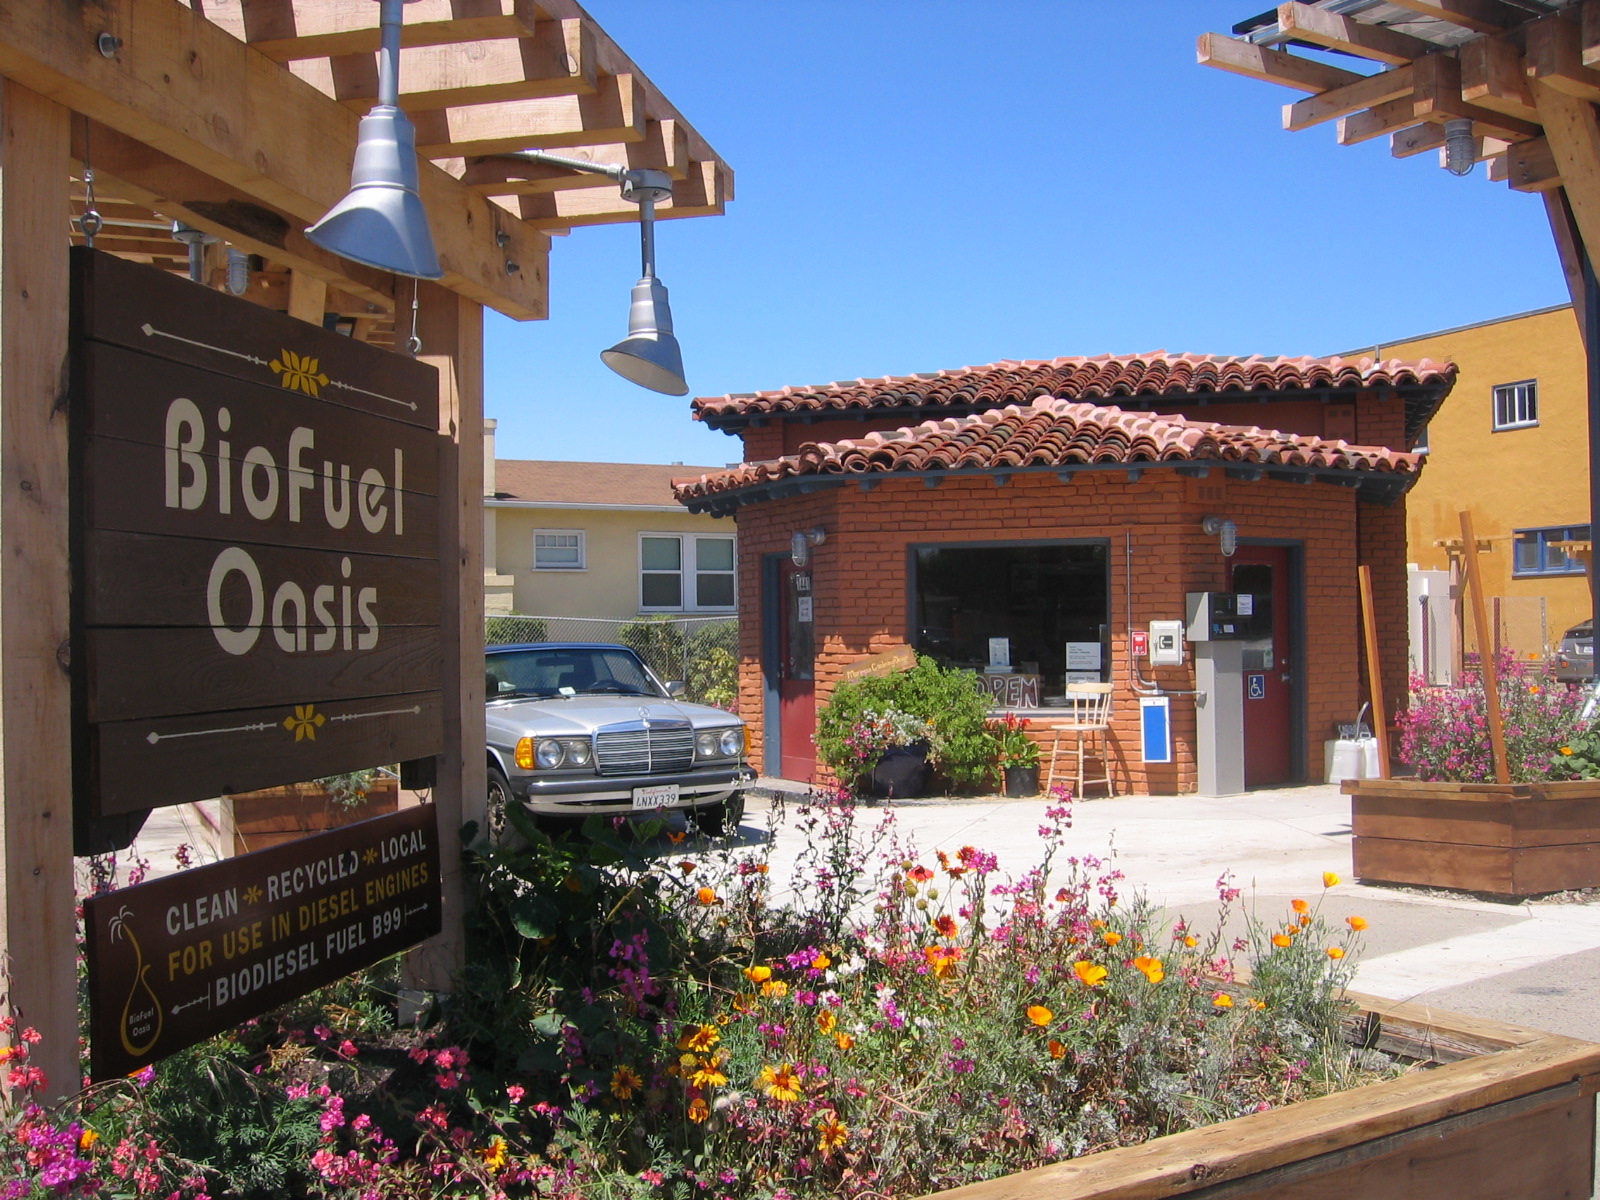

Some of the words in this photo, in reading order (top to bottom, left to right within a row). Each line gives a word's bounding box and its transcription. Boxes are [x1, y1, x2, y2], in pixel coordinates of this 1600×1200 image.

[206, 546, 379, 656] Oasis
[165, 887, 238, 936] CLEAN
[267, 849, 359, 902] RECYCLED
[380, 829, 427, 864] LOCAL
[168, 940, 213, 982] FOR
[223, 918, 263, 959] USE
[271, 909, 291, 942] IN
[299, 890, 359, 932] DIESEL
[366, 862, 429, 906] ENGINES
[215, 941, 319, 1007] BIODIESEL
[326, 921, 367, 959] FUEL
[373, 907, 402, 939] B99
[132, 1024, 151, 1037] Oasis
